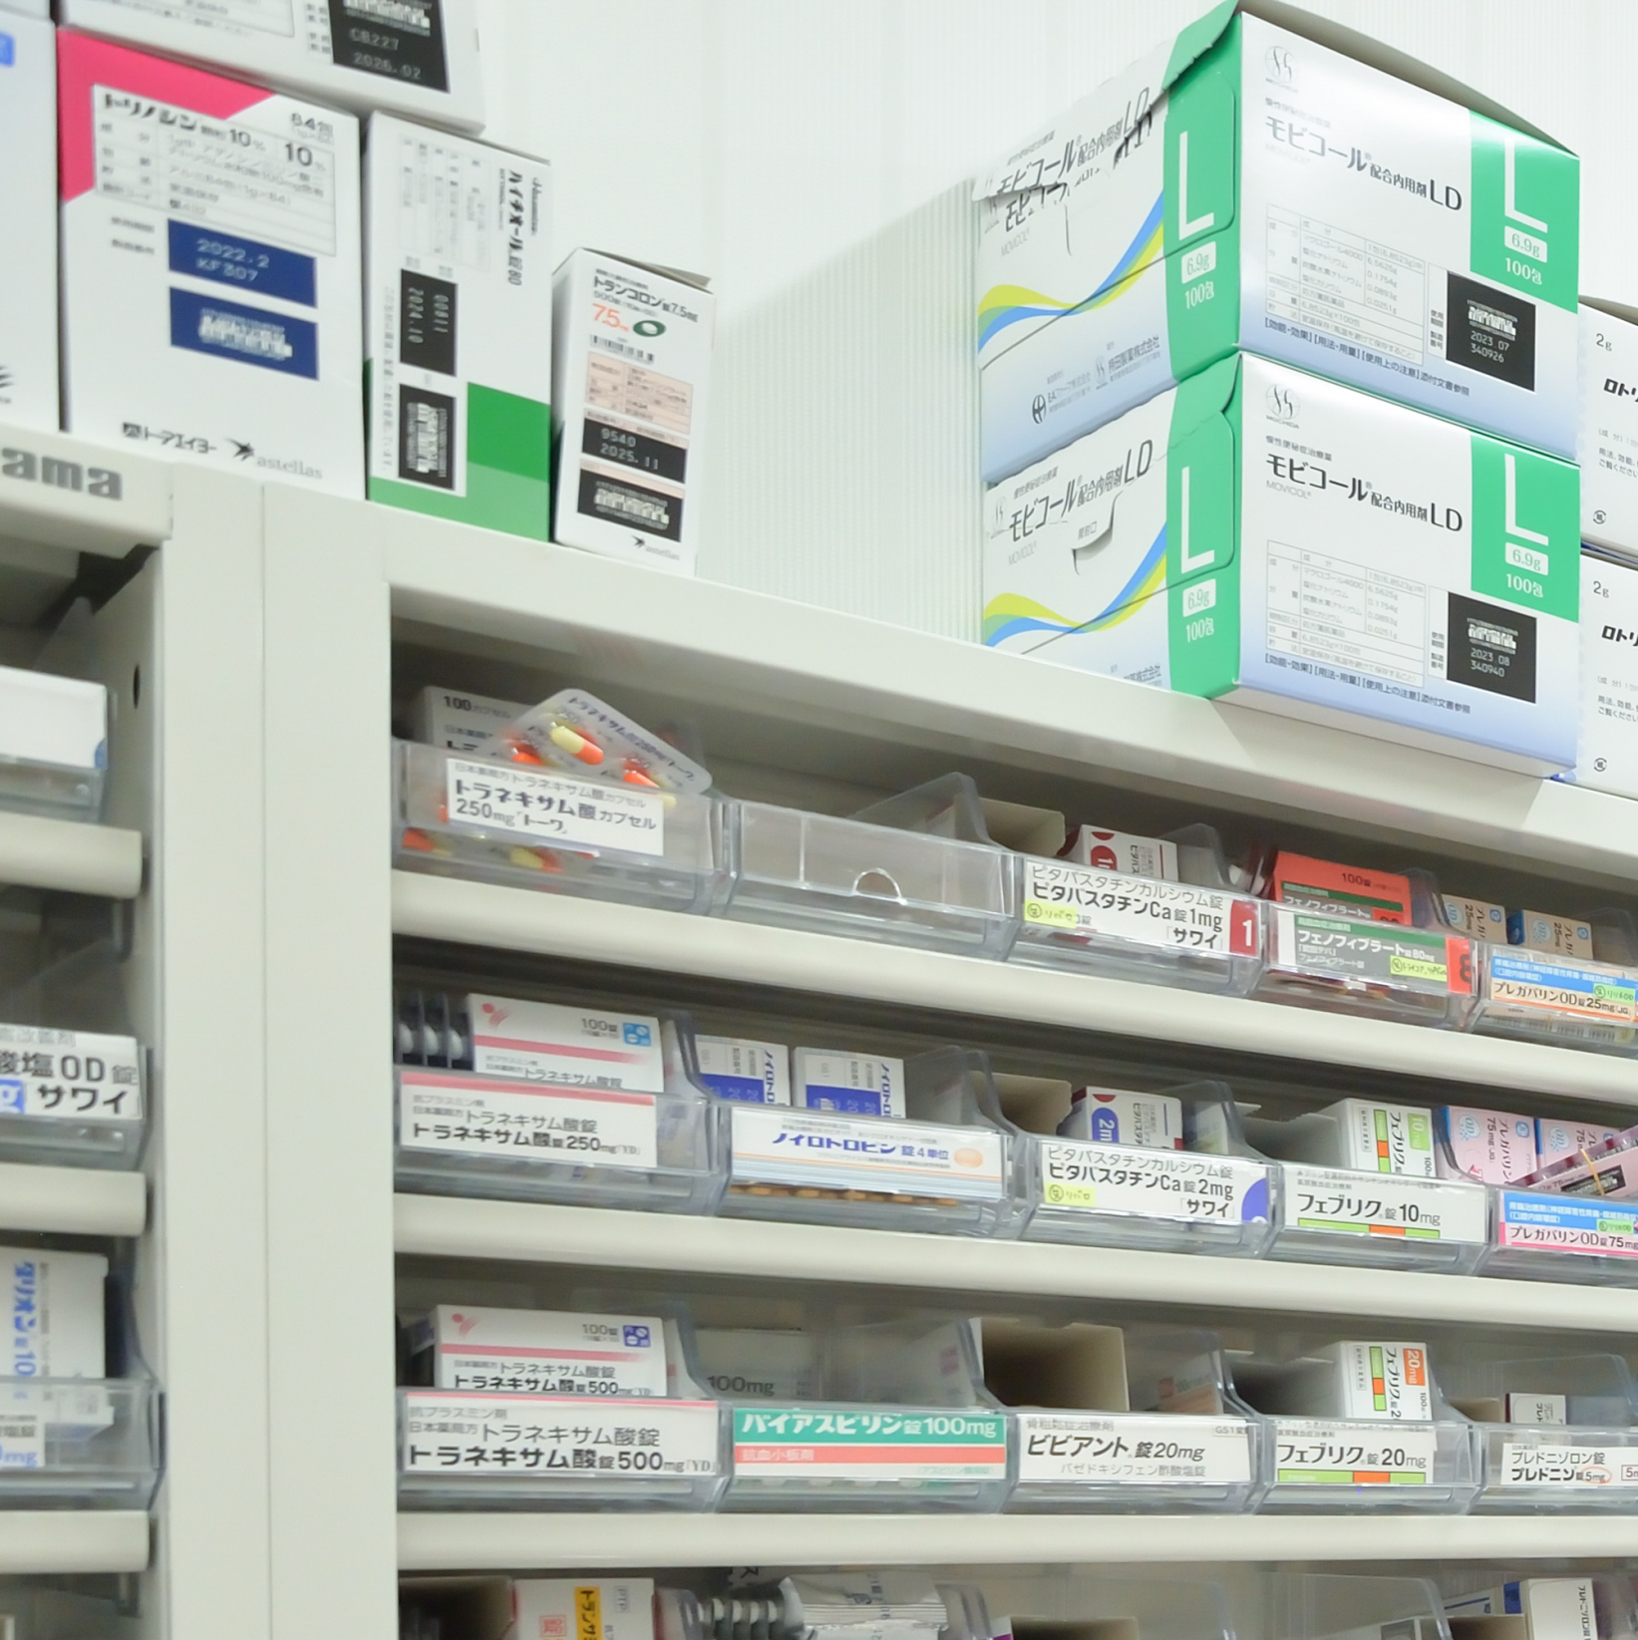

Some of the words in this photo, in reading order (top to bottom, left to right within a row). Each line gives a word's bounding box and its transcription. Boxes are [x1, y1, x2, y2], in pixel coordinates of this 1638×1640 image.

[1179, 131, 1214, 240] L
[1504, 135, 1548, 234] L
[1509, 232, 1542, 256] 6.9g
[1183, 250, 1209, 275] 6.9g
[1504, 257, 1543, 285] 100包
[1184, 280, 1215, 308] 100包
[1595, 333, 1613, 352] 2g
[257, 454, 323, 480] astellas
[1505, 454, 1549, 546] L
[1511, 548, 1543, 573] 6.9g
[1505, 572, 1545, 600] 100包
[1592, 581, 1610, 599] 2g
[1242, 918, 1252, 947] 1
